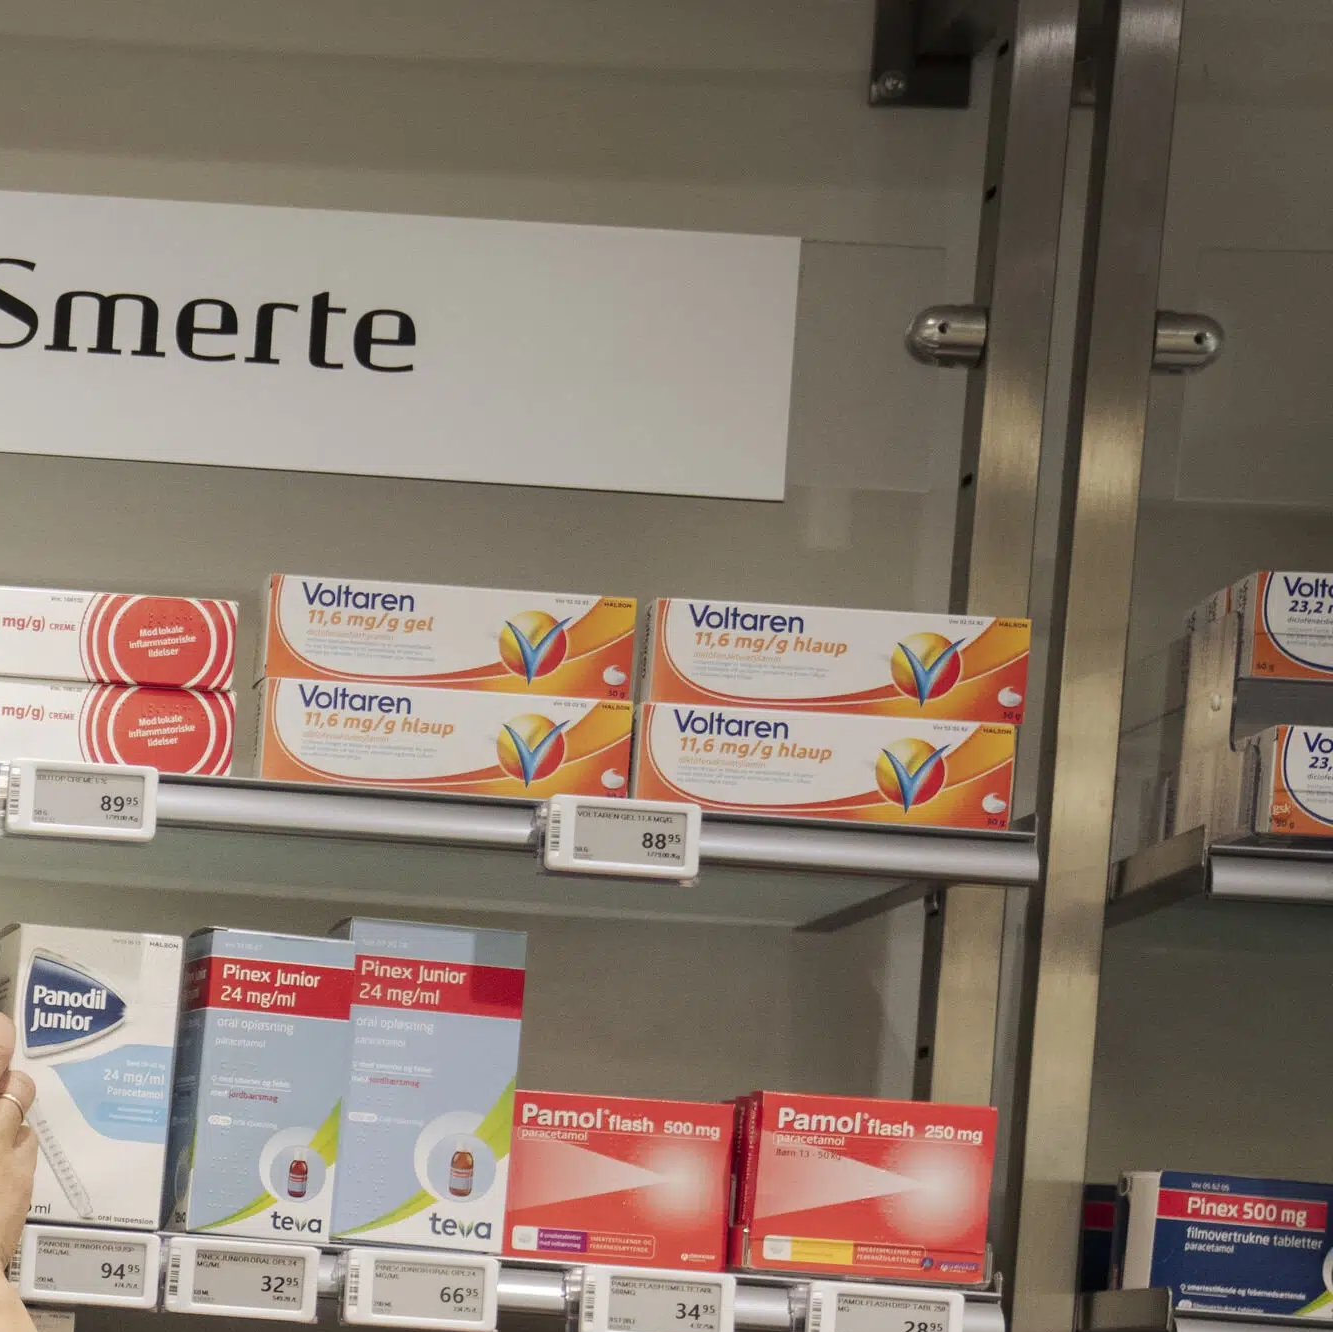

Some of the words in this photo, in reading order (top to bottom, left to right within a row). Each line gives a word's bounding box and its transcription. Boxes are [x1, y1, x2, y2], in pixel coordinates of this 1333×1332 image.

[302, 582, 415, 612] Voltaren
[2, 614, 46, 631] mg/g)
[308, 609, 341, 626] 11,6
[347, 612, 398, 632] mg/g
[404, 616, 434, 632] gel
[689, 604, 804, 634] Voltaren
[299, 684, 411, 715] Voltaren
[673, 709, 789, 740] Voltaren
[222, 964, 267, 984] Pinex
[272, 970, 321, 989] Junior
[33, 985, 107, 1011] Panodil
[31, 1009, 93, 1033] Junior
[609, 1116, 653, 1132] flash
[663, 1122, 692, 1135] 500
[695, 1123, 720, 1139] mg
[867, 1120, 914, 1137] flash
[924, 1125, 954, 1140] 250
[956, 1128, 982, 1144] mg
[271, 1210, 322, 1235] teva
[1187, 1196, 1238, 1217] Pinex
[1243, 1202, 1277, 1220] 500
[1281, 1207, 1306, 1226] mg
[429, 1213, 492, 1240] teva
[1186, 1226, 1270, 1246] filmovertrukne
[1273, 1233, 1323, 1249] tabletter
